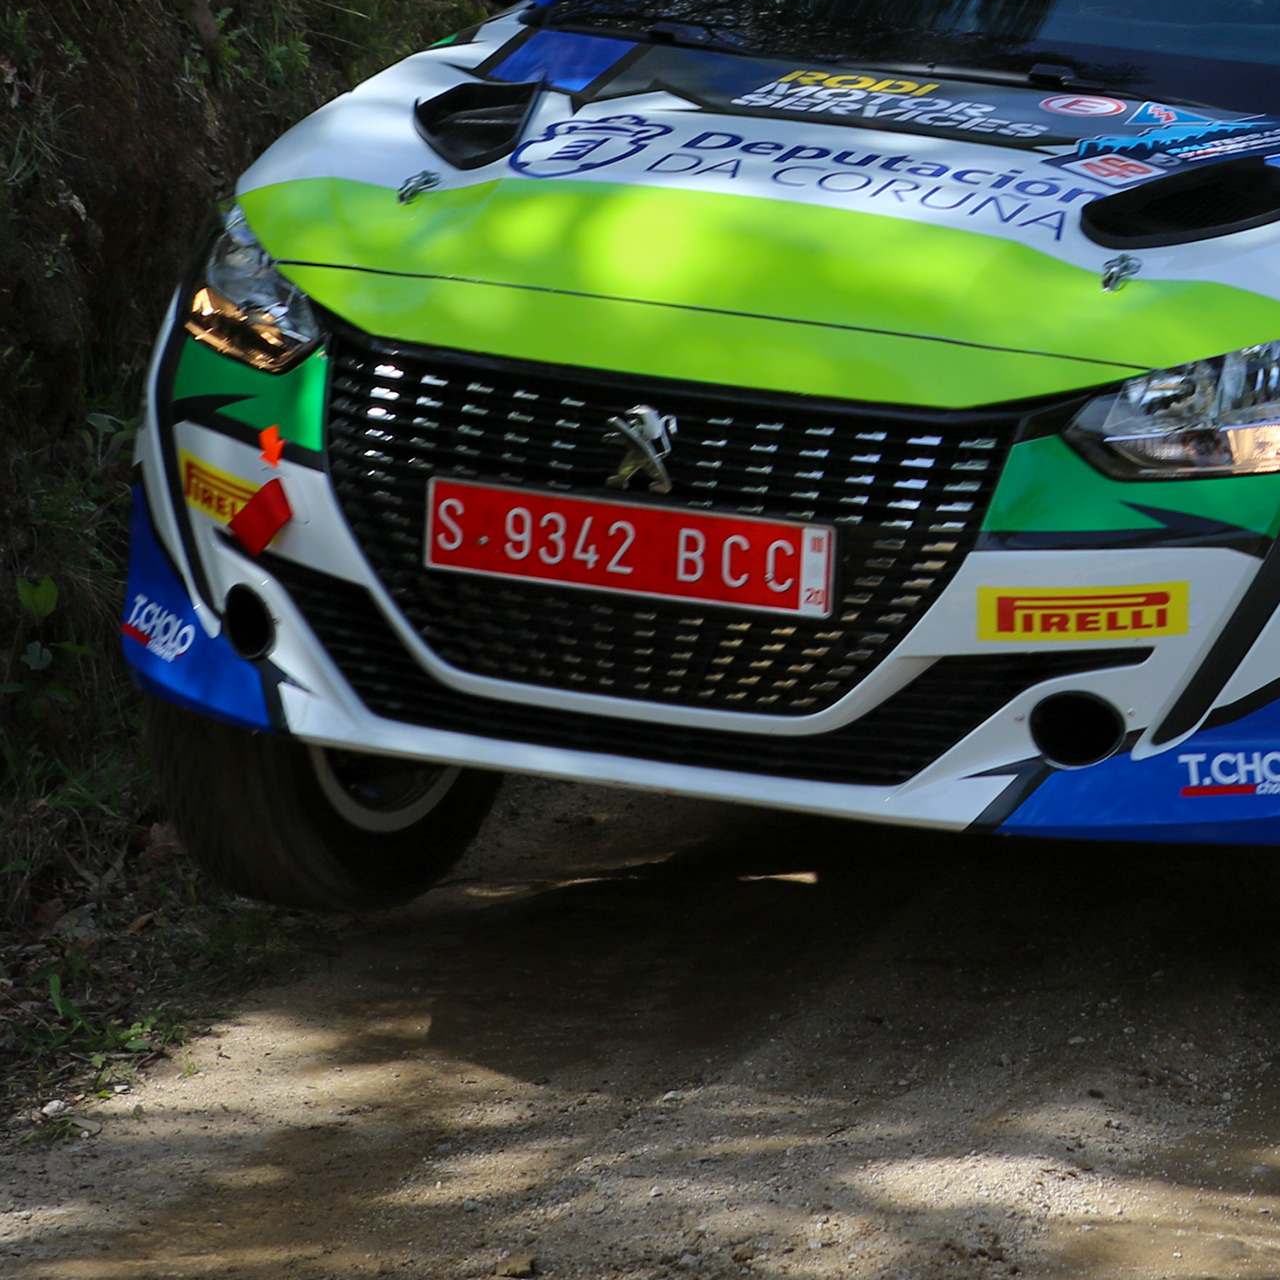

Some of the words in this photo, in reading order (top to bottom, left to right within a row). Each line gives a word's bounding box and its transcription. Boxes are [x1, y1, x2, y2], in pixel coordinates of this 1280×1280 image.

[753, 82, 997, 117] MOTOR
[778, 70, 940, 97] RODI
[731, 93, 1049, 138] SERVICES
[681, 131, 1106, 204] Deputación
[645, 153, 741, 180] DA
[770, 165, 1068, 241] CORUÑA
[184, 459, 257, 519] PIREL
[437, 498, 465, 551] S
[504, 506, 636, 575] 9342
[677, 527, 795, 593] BCC
[996, 591, 1170, 634] PIRELLI
